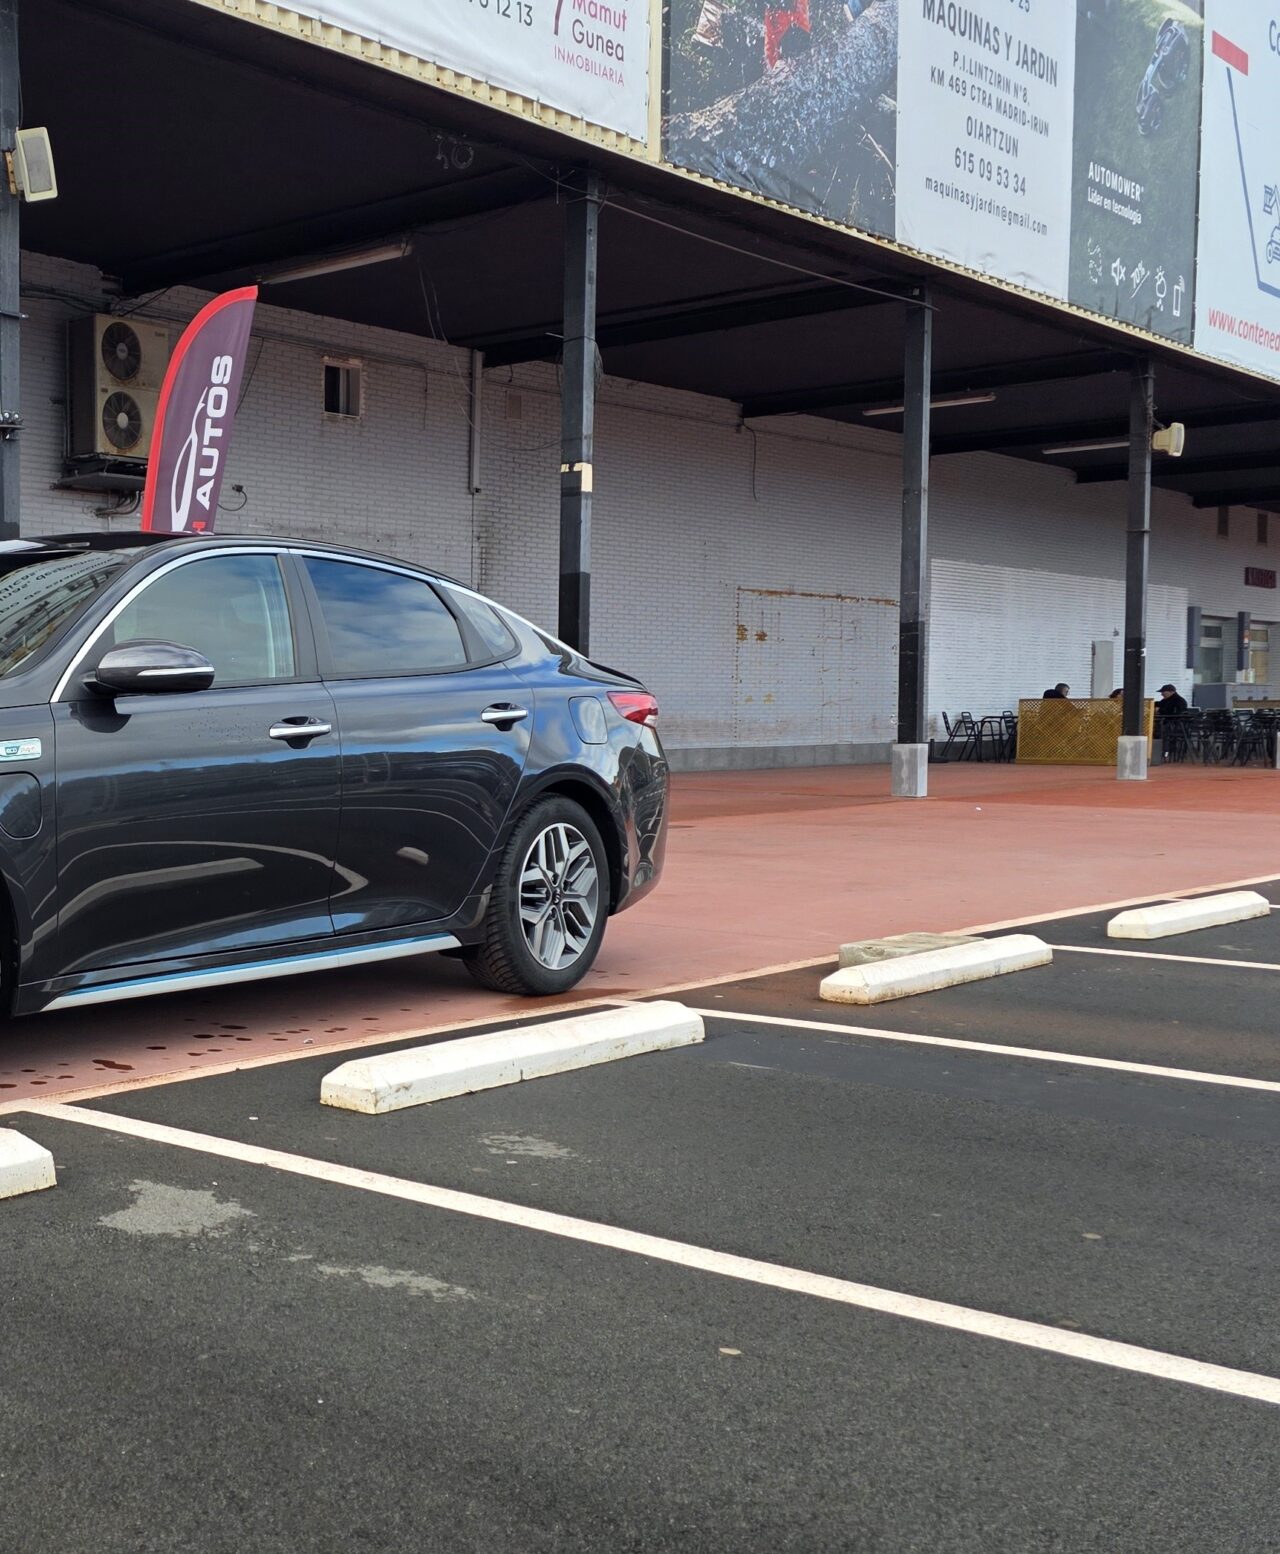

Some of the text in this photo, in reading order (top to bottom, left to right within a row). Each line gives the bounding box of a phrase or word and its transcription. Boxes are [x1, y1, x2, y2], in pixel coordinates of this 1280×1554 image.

[516, 1, 533, 27] 13
[572, 0, 627, 32] Mamut
[571, 18, 625, 62] Gunea
[922, 0, 1058, 88] MAQUINAS Y JARDIN
[553, 44, 625, 87] INMOBILIARIA
[930, 65, 1049, 138] KM 469 CTRA MADRID-IRUN
[966, 115, 1019, 158] OIARTZUN
[954, 147, 1026, 197] 615 09 53 34
[925, 176, 1048, 236] maquinasyjardin@gmail.com
[195, 354, 234, 512] AUTOS
